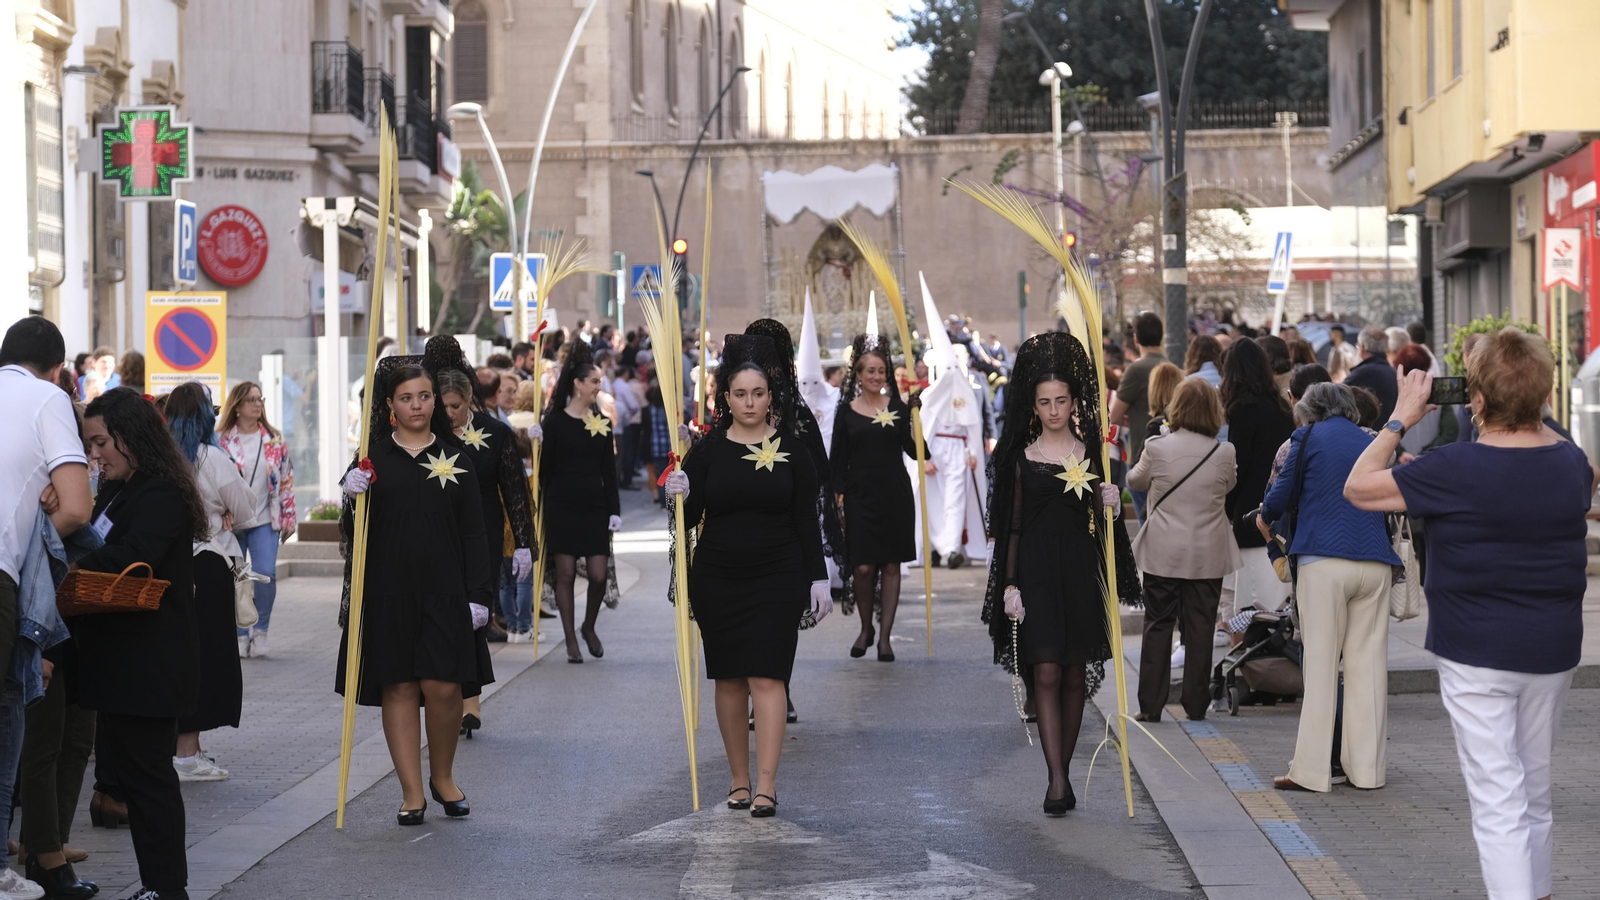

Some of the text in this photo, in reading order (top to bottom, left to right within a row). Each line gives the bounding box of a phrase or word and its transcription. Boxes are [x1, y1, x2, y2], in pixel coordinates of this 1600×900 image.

[213, 166, 237, 179] LUIS
[243, 167, 294, 181] GAZQUEZ
[182, 213, 193, 264] P
